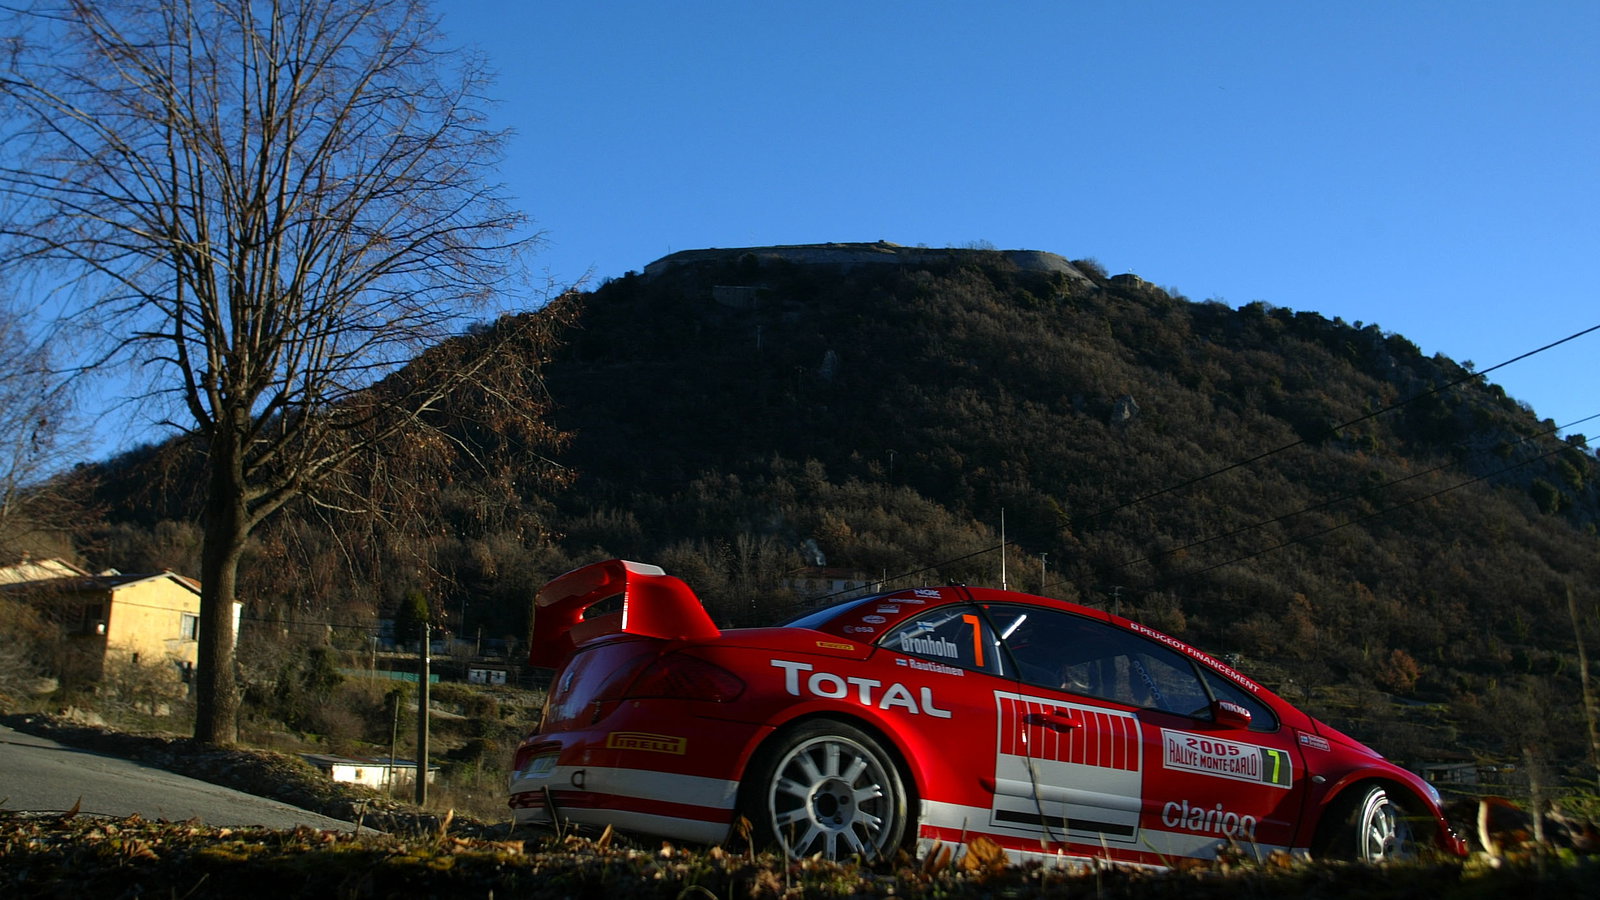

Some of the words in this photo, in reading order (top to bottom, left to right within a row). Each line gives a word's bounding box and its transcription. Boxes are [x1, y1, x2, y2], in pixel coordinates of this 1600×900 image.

[900, 632, 959, 659] Gronholm
[962, 614, 984, 667] 7
[909, 658, 965, 677] Rautiainen
[1140, 627, 1186, 651] PEUGEOT
[1187, 647, 1260, 693] FINANCEMENT
[770, 659, 952, 719] TOTAL
[612, 733, 678, 752] PIRELLI
[1169, 738, 1198, 766] RALLYE
[1200, 753, 1257, 777] MONTE-CARLO
[1186, 737, 1240, 756] 2005
[1266, 750, 1281, 784] 7
[1162, 800, 1257, 837] Clarion
